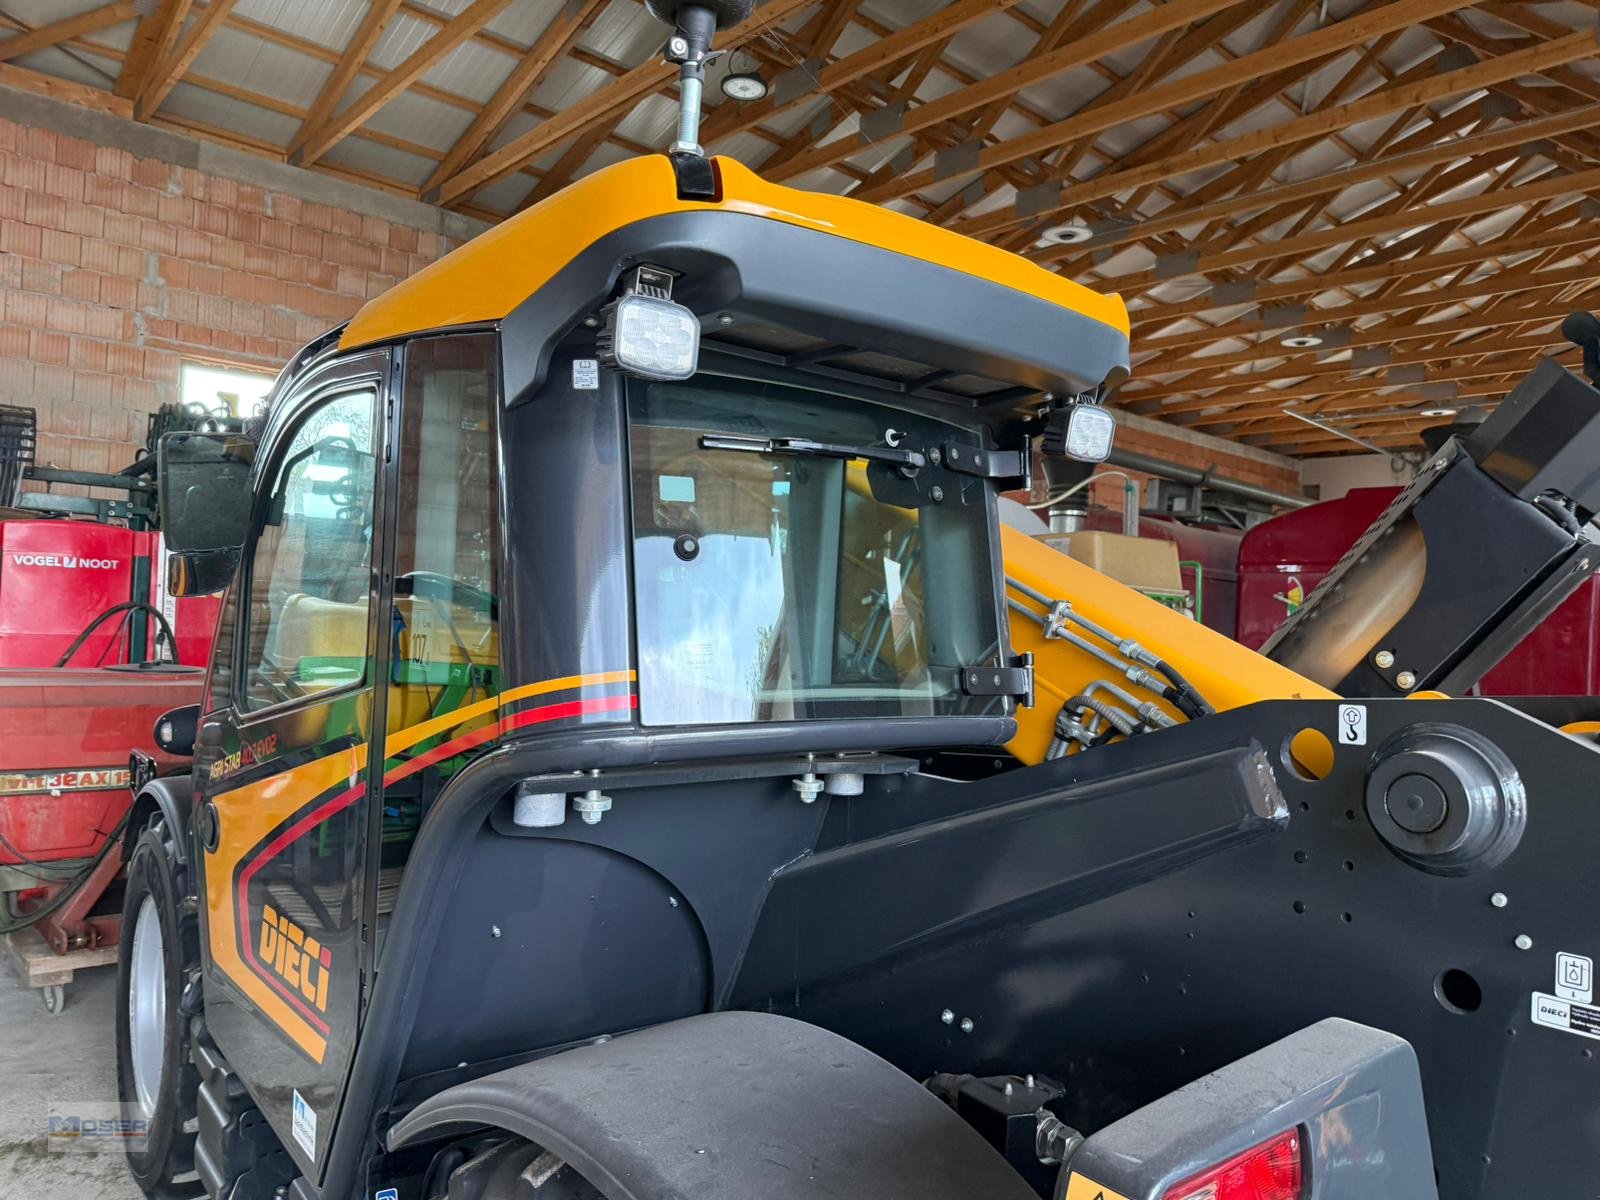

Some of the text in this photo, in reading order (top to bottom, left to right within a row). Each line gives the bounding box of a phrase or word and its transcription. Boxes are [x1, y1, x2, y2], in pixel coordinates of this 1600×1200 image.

[13, 554, 119, 570] VOGEL NOOT
[259, 904, 332, 1013] DIECI
